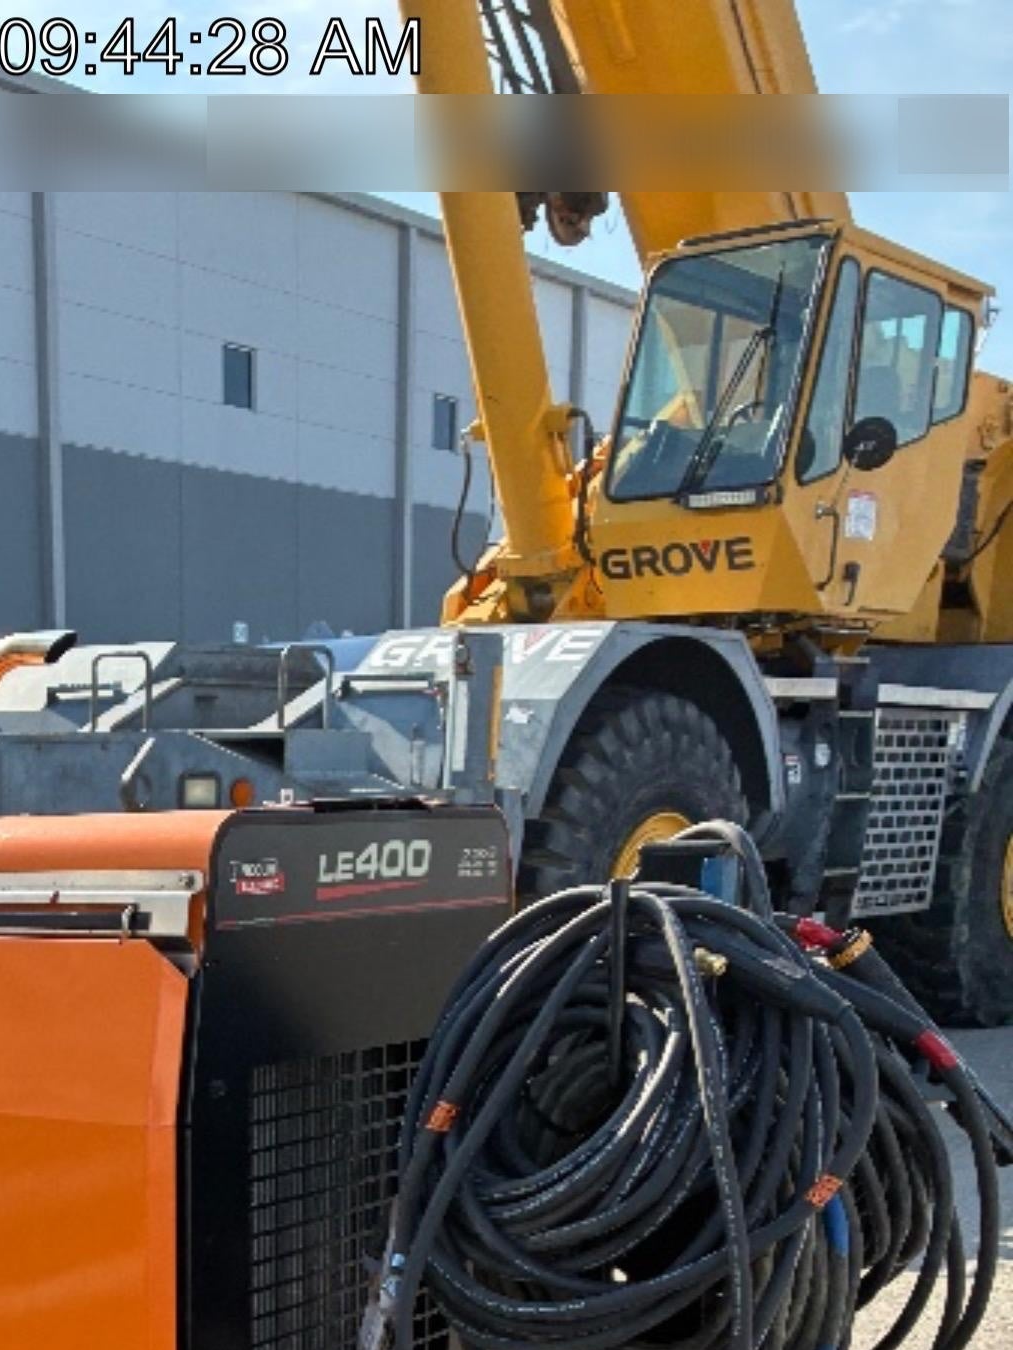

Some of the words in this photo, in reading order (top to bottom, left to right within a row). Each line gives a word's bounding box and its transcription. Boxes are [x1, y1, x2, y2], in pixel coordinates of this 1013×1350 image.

[600, 536, 755, 579] GROVE
[371, 628, 603, 667] GRVE
[318, 840, 432, 883] LE400
